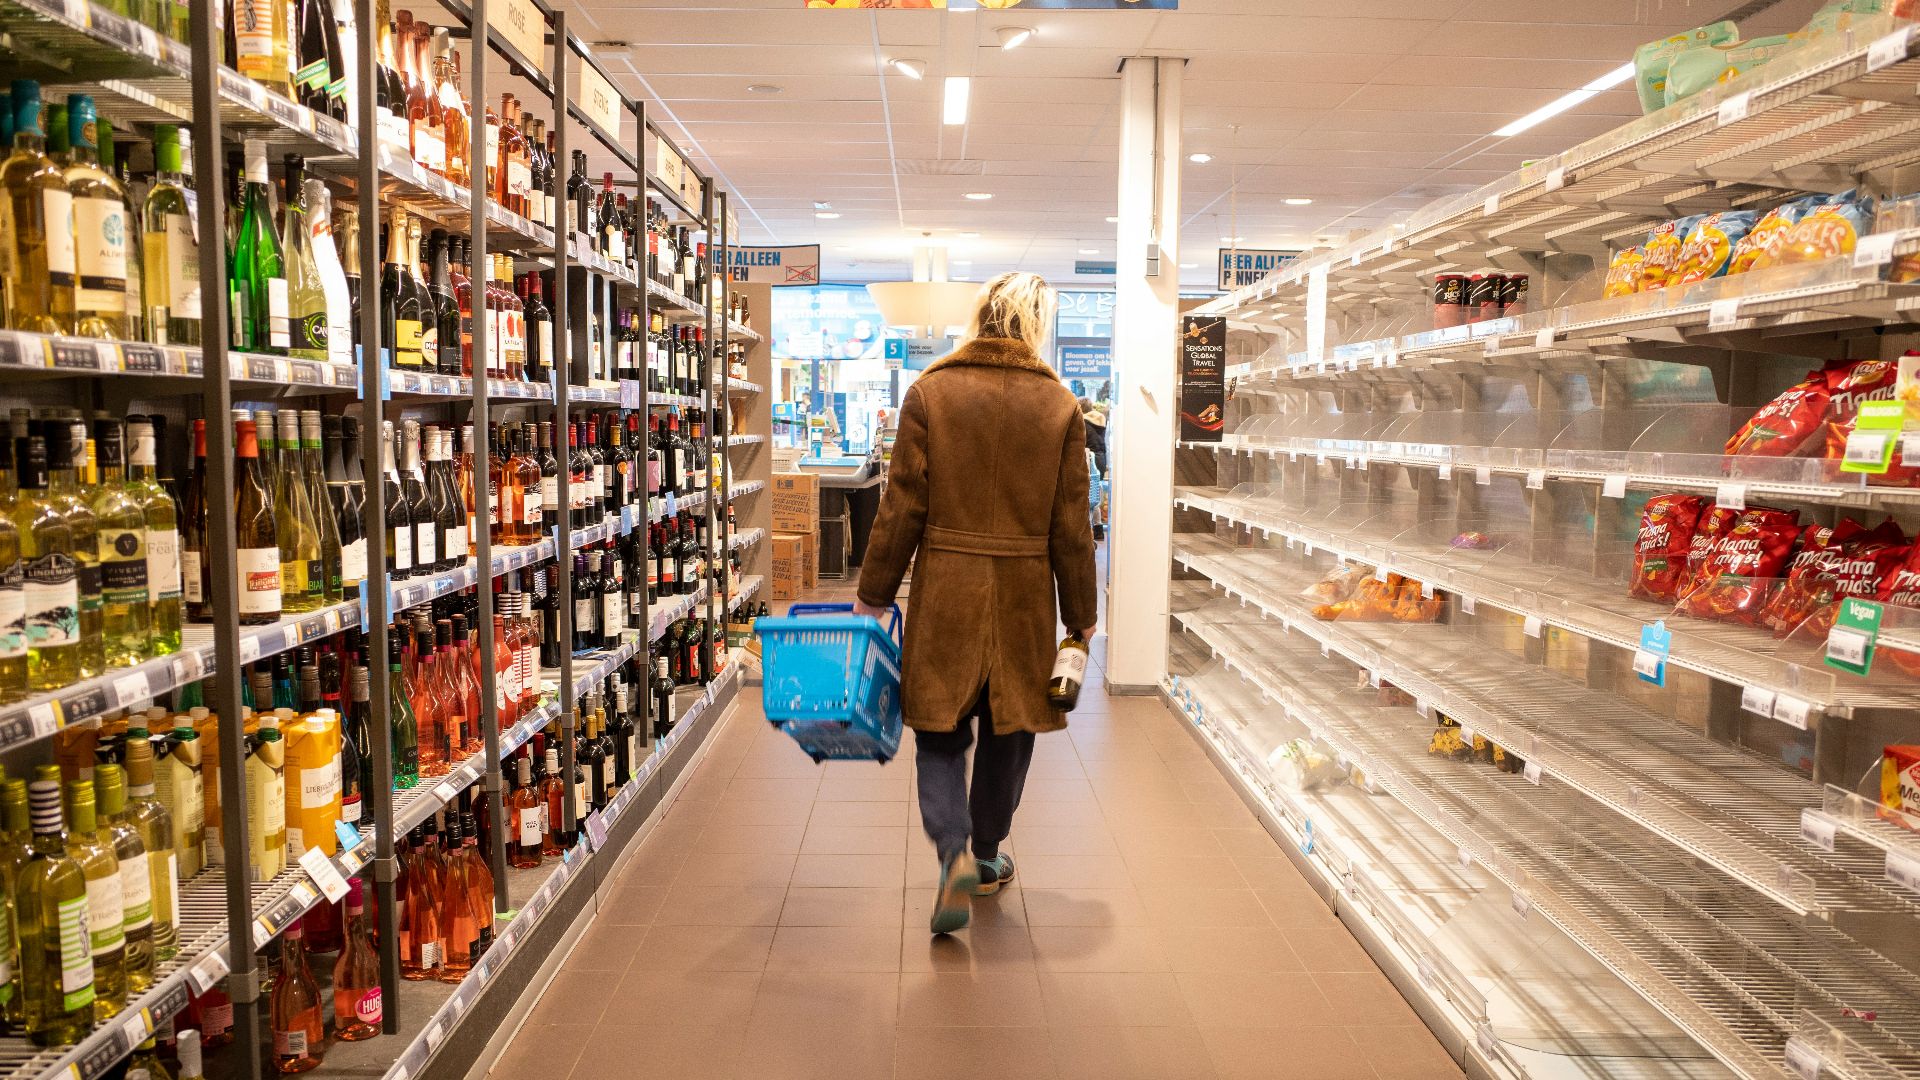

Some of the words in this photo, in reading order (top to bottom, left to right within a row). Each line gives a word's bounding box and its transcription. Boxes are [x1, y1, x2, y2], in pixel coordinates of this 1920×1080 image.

[508, 3, 526, 34] ROSÉ
[735, 250, 781, 266] ALLEEN
[890, 343, 898, 355] 5
[1185, 344, 1223, 352] SENSATIONS
[1065, 352, 1093, 360] Bloemen
[1192, 359, 1216, 367] TRAVEL
[1849, 601, 1876, 621] Vegan
[362, 997, 382, 1014] HUG
